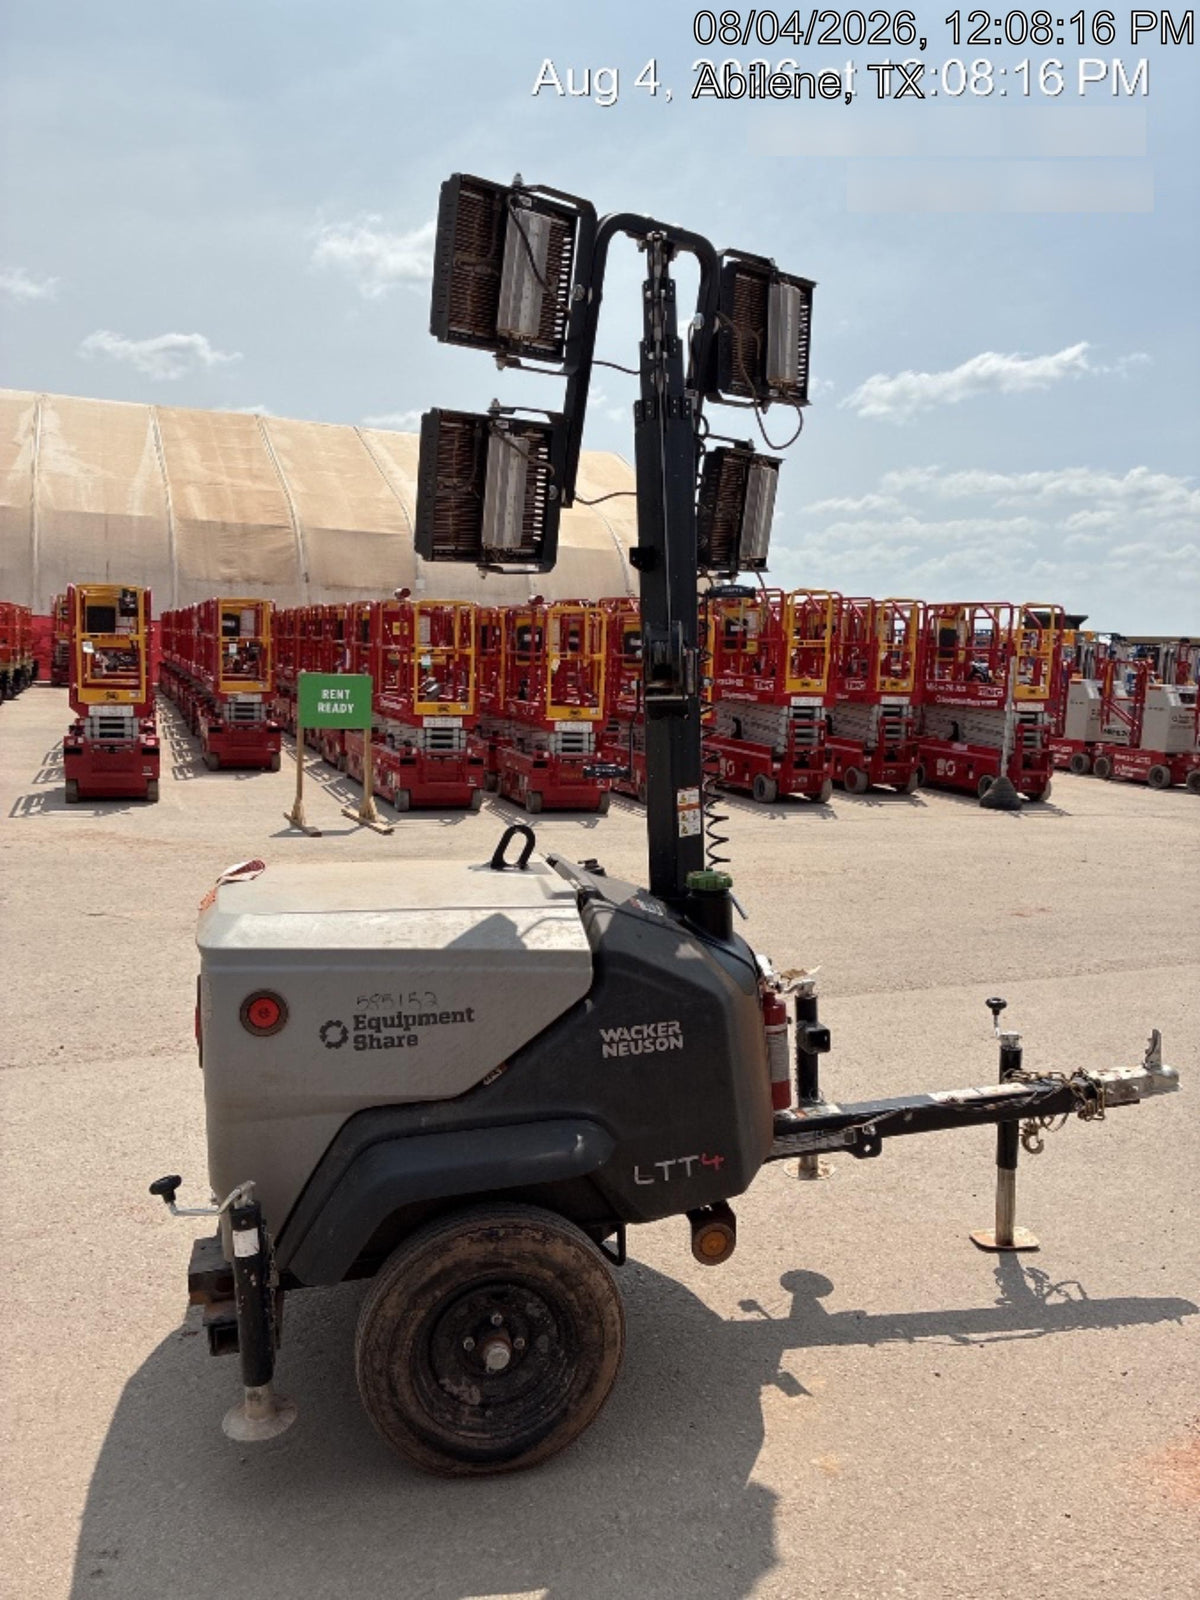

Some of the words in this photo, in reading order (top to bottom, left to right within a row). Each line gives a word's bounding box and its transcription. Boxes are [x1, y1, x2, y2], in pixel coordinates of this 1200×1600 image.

[321, 689, 351, 700] RENT
[317, 702, 355, 714] READY
[353, 1007, 475, 1033] Equipment
[600, 1020, 682, 1042] WACKER
[353, 1034, 419, 1051] Share
[602, 1035, 684, 1058] NEUSON
[633, 1153, 725, 1185] LTT4
